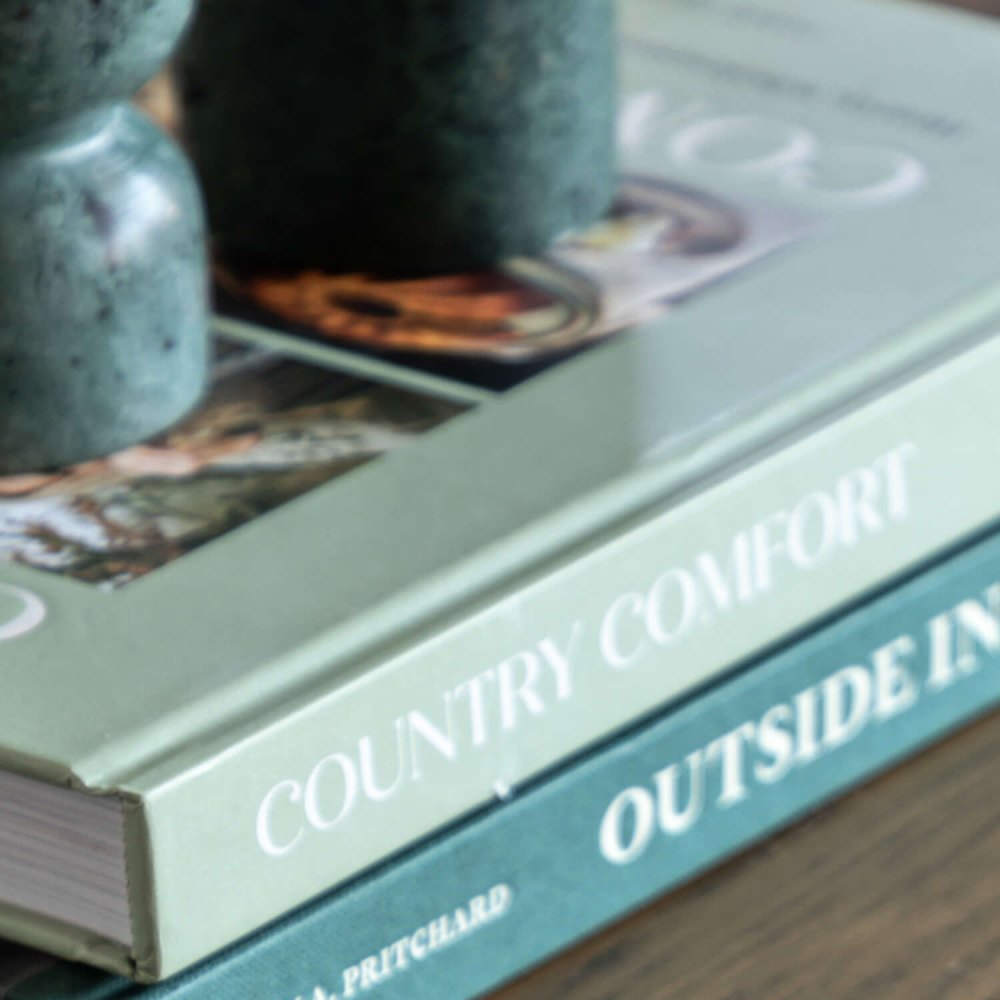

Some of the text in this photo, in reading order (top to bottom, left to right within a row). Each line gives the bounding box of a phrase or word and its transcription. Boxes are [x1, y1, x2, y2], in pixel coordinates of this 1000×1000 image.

[255, 441, 919, 857] COUNTRY COMFORT
[599, 633, 918, 866] OUTSIDE
[341, 883, 513, 1000] PRITCHARD
